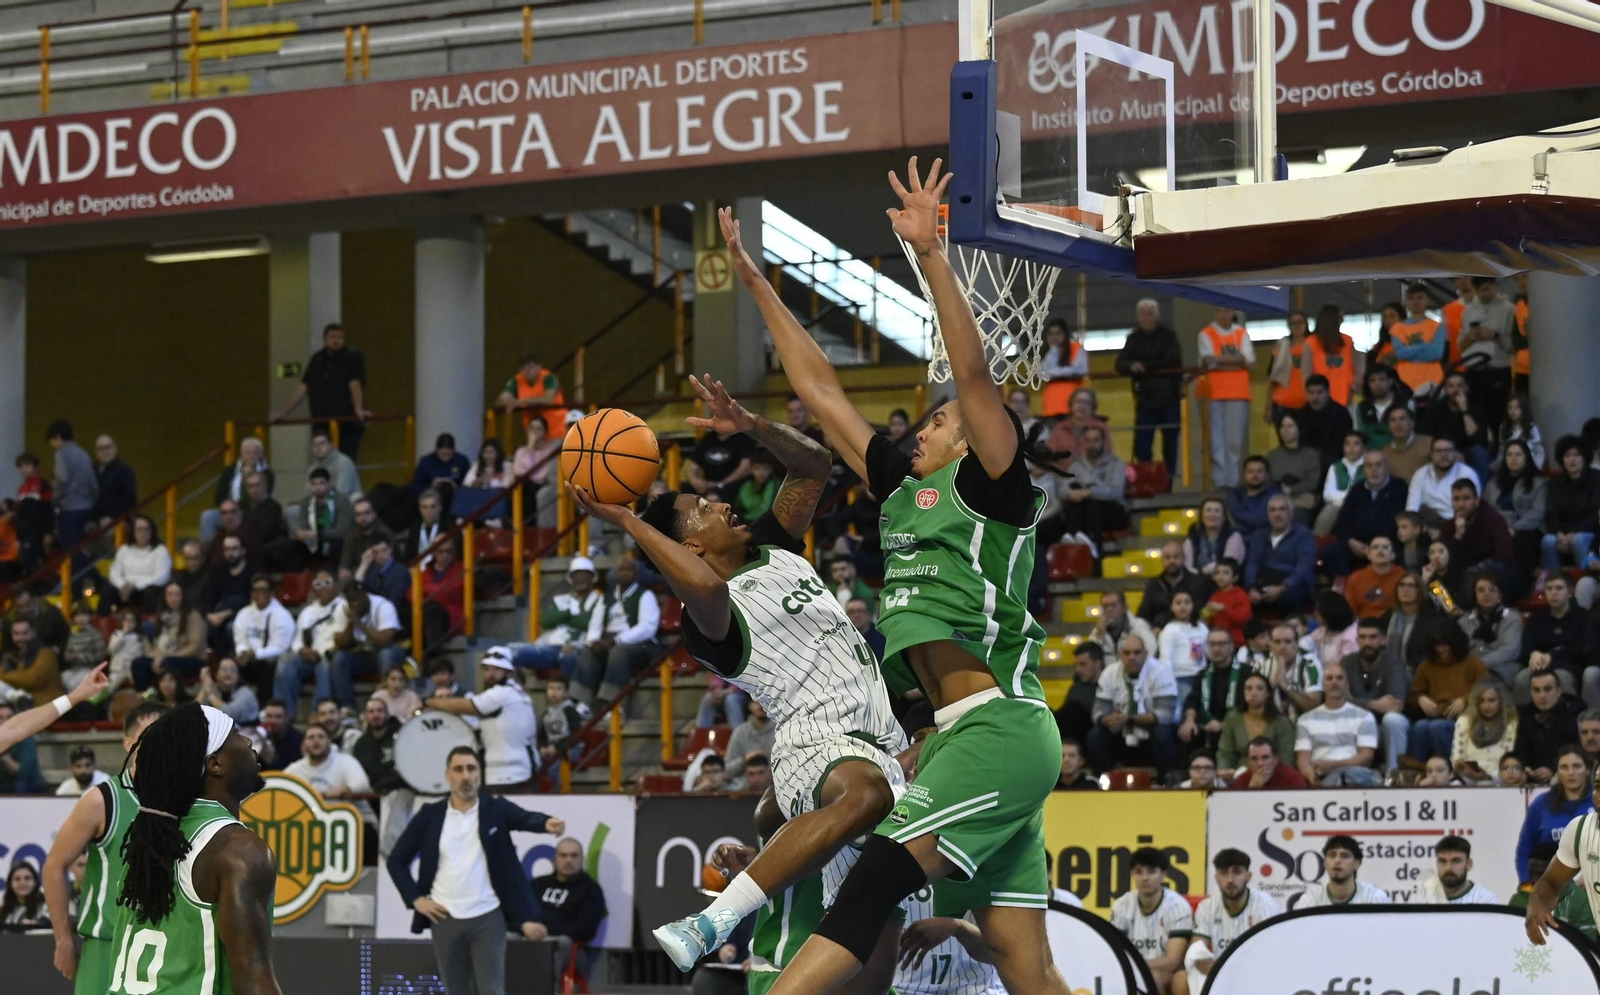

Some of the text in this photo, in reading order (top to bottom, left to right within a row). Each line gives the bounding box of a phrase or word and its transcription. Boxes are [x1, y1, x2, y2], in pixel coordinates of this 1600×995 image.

[1127, 0, 1486, 81] IMDECO
[410, 47, 808, 113] PALACIO MUNICIPAL DEPORTES
[1031, 107, 1114, 130] Instito
[1119, 91, 1223, 119] Muncipal
[1381, 66, 1483, 94] Córdoba
[382, 81, 851, 185] VISTA ALEGRE
[52, 196, 74, 217] de
[78, 192, 157, 216] Deportes
[160, 183, 234, 207] Córdoba
[1273, 802, 1315, 822] San
[1323, 800, 1397, 822] Carlos
[1418, 801, 1435, 821] &
[1396, 862, 1420, 880] de
[109, 924, 168, 994] 10
[931, 954, 952, 985] 17
